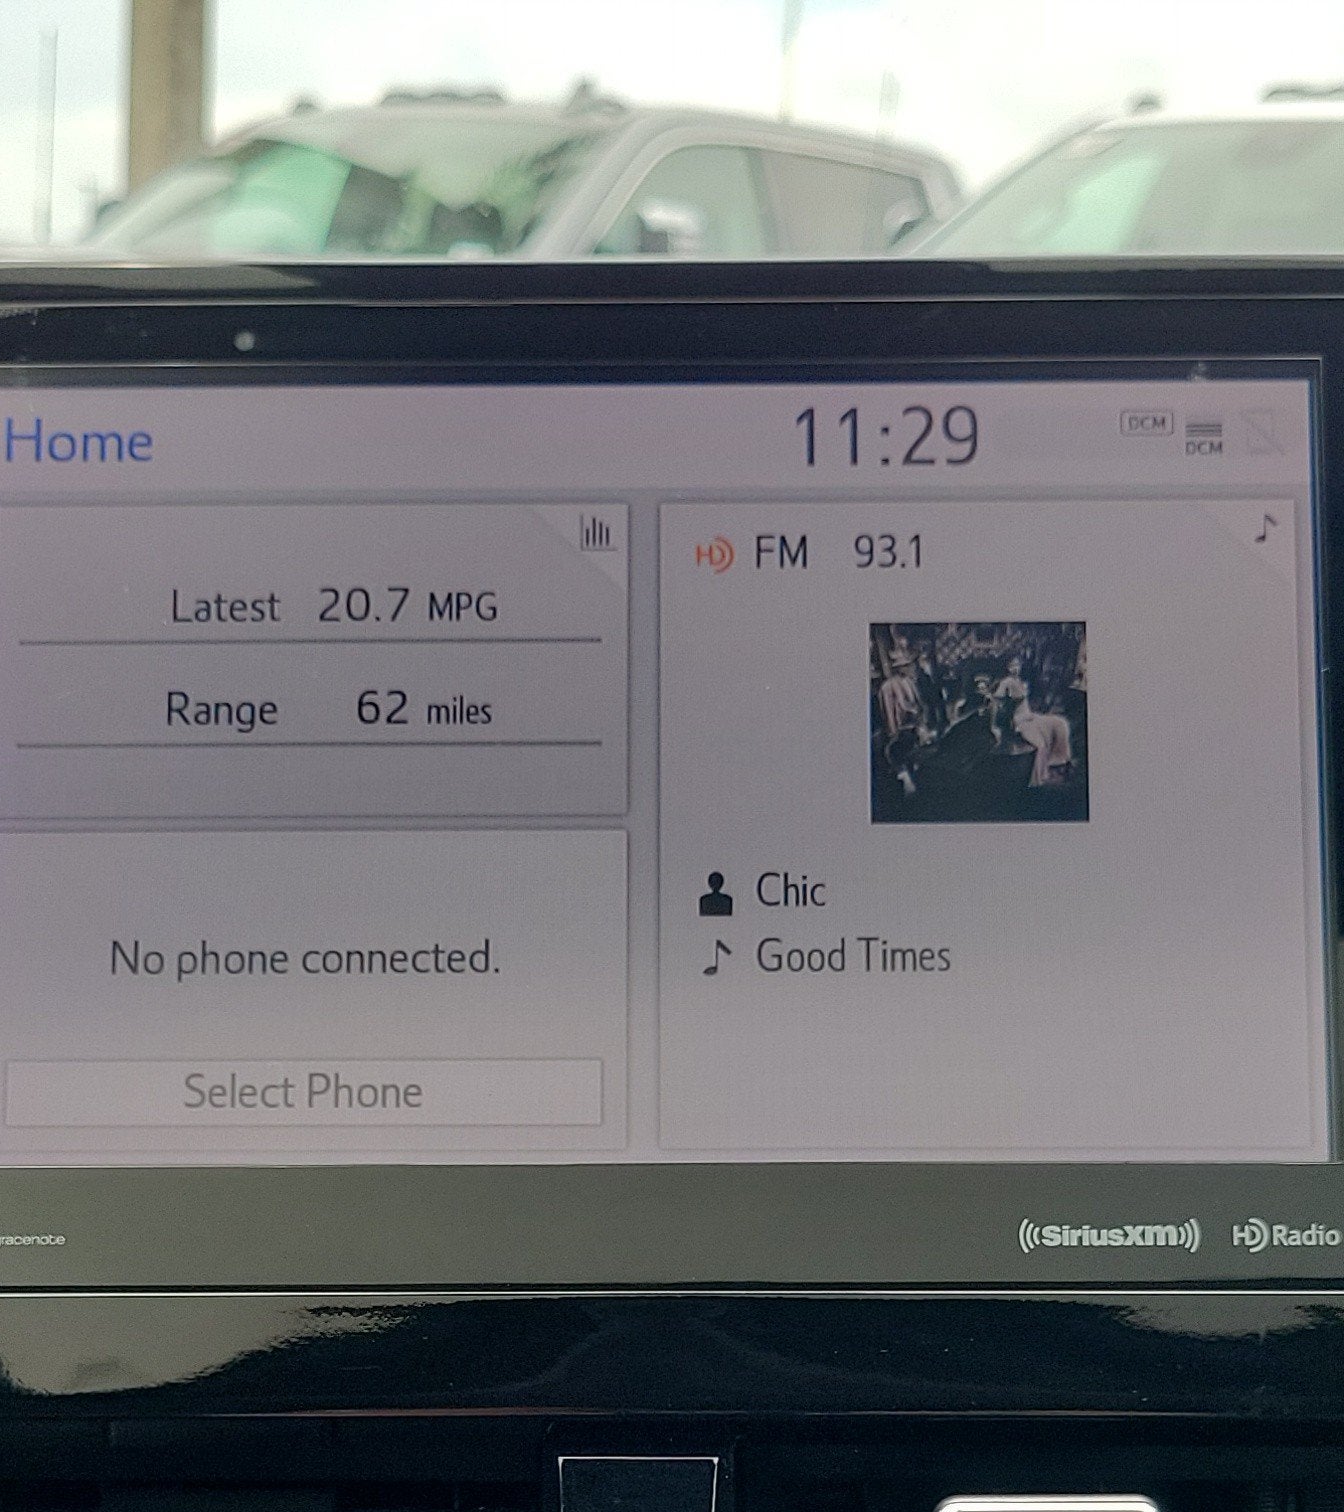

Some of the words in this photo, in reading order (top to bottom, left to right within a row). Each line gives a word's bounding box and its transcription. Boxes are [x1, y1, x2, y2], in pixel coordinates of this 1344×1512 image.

[4, 417, 154, 463] Home
[794, 404, 980, 467] 11:29
[1128, 415, 1167, 431] DCM
[1184, 440, 1224, 456] DCM
[755, 535, 810, 569] FM
[854, 534, 923, 569] 93.1
[171, 588, 281, 624] Latest
[318, 587, 410, 623] 20.7
[427, 591, 498, 622] MPG
[166, 690, 279, 733] Range
[357, 690, 409, 726] 62
[426, 695, 493, 726] miles
[756, 872, 827, 908] Chic
[110, 940, 165, 976] No
[177, 939, 290, 983] phone
[301, 938, 501, 975] connected.
[756, 936, 846, 973] Good
[856, 936, 952, 973] Times
[183, 1072, 296, 1109] Select
[308, 1072, 423, 1109] Phone
[1271, 1224, 1343, 1247] Radio
